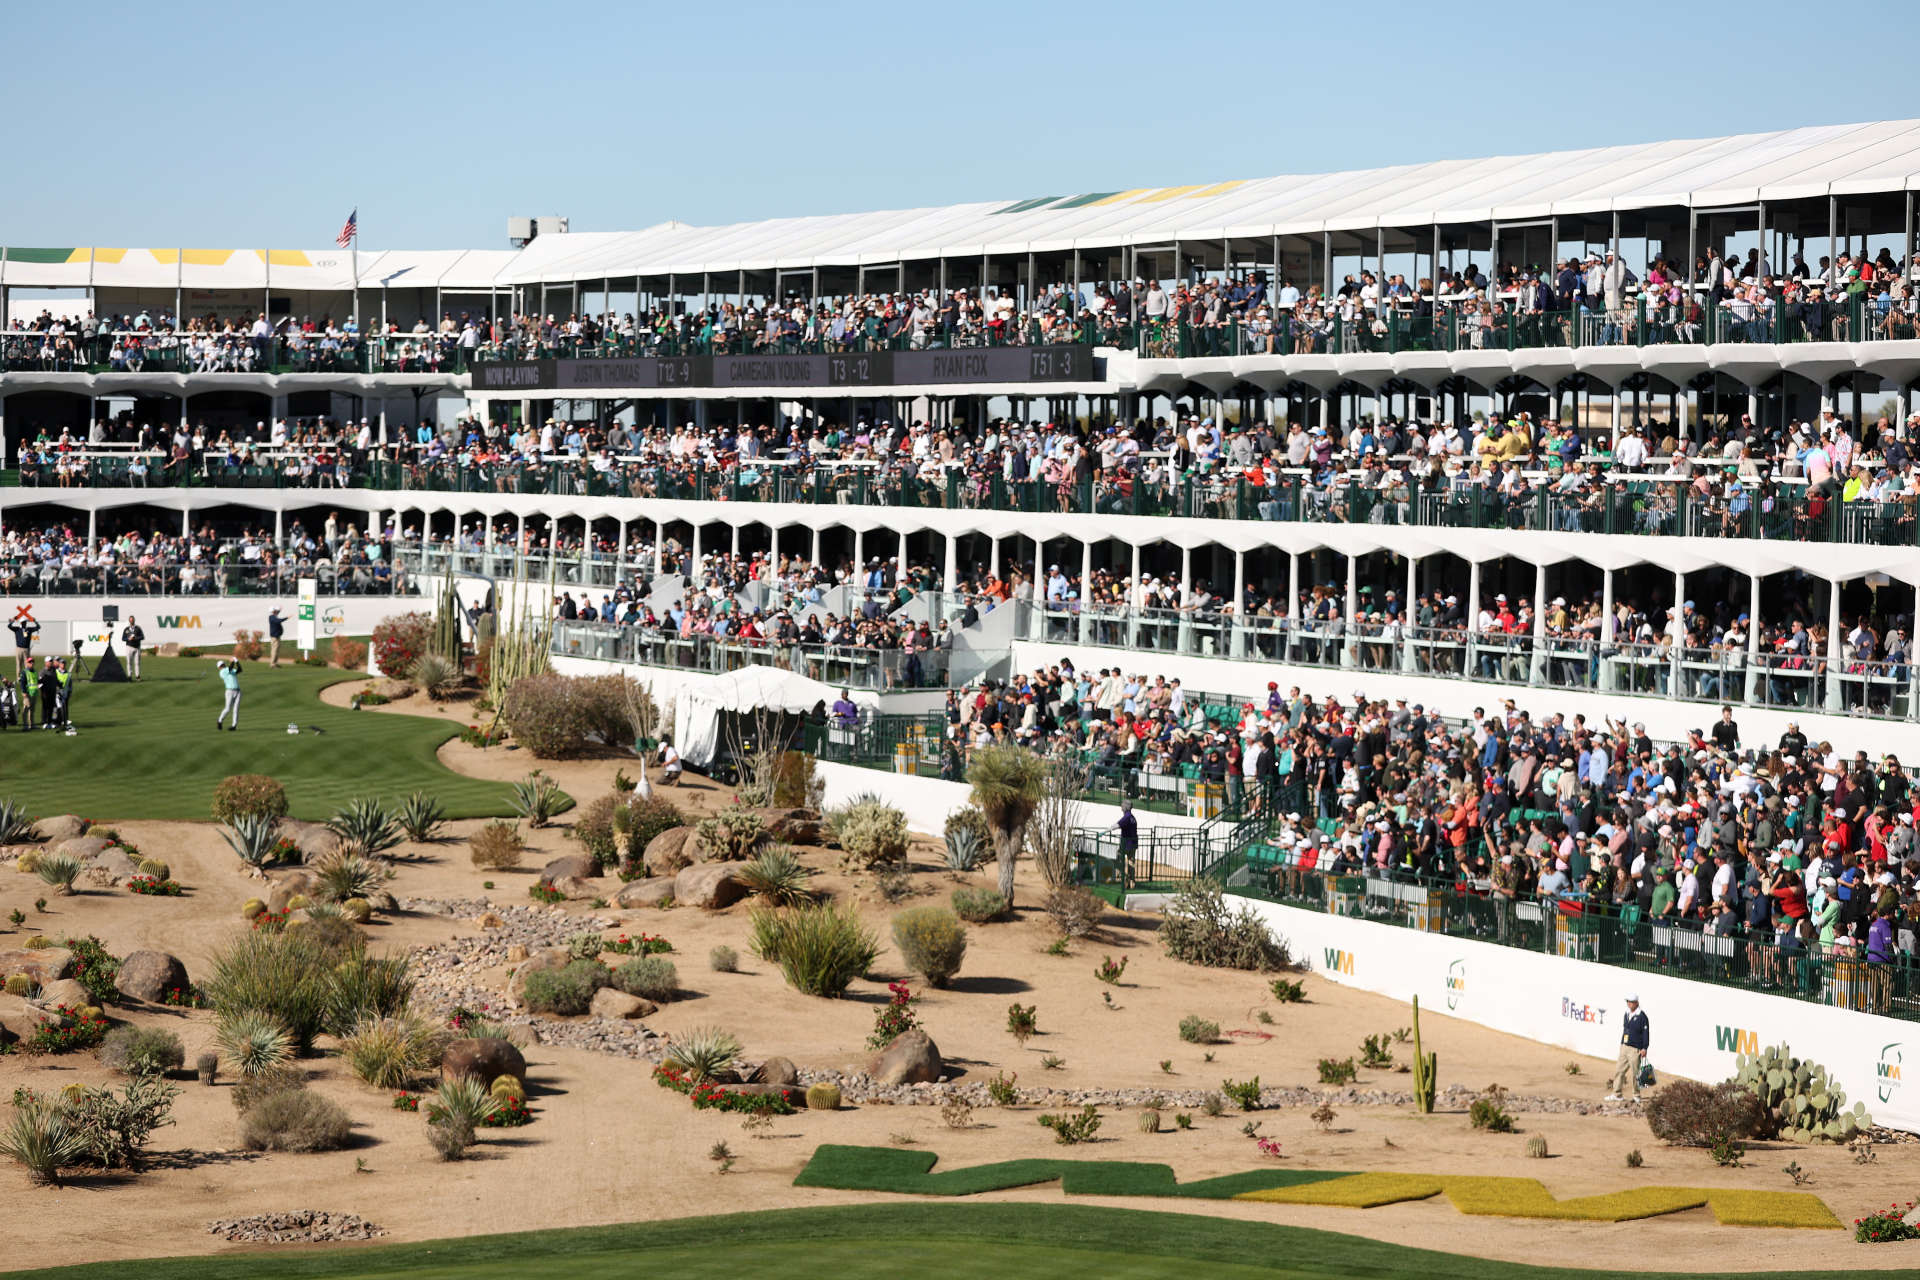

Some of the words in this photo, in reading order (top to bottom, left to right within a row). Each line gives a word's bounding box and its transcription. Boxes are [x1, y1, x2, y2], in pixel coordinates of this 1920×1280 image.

[485, 366, 504, 385] NOW
[505, 366, 539, 385] PLAYING
[604, 363, 640, 383] THOMAS
[658, 362, 675, 382] T12
[680, 363, 690, 382] -9
[730, 361, 776, 381] CAMERON
[778, 360, 810, 381] YOUNG
[833, 359, 846, 381] T3
[852, 359, 869, 380] -12
[933, 356, 962, 377] RYAN
[965, 355, 988, 376] FOX
[1033, 353, 1053, 375] T51
[1060, 353, 1072, 375] -3
[157, 615, 201, 628] WM
[322, 616, 344, 624] WM
[1325, 947, 1354, 976] WM
[1447, 976, 1464, 990] WM
[1570, 1002, 1596, 1023] FedEx
[1715, 1024, 1760, 1059] WM
[1877, 1062, 1901, 1080] WM
